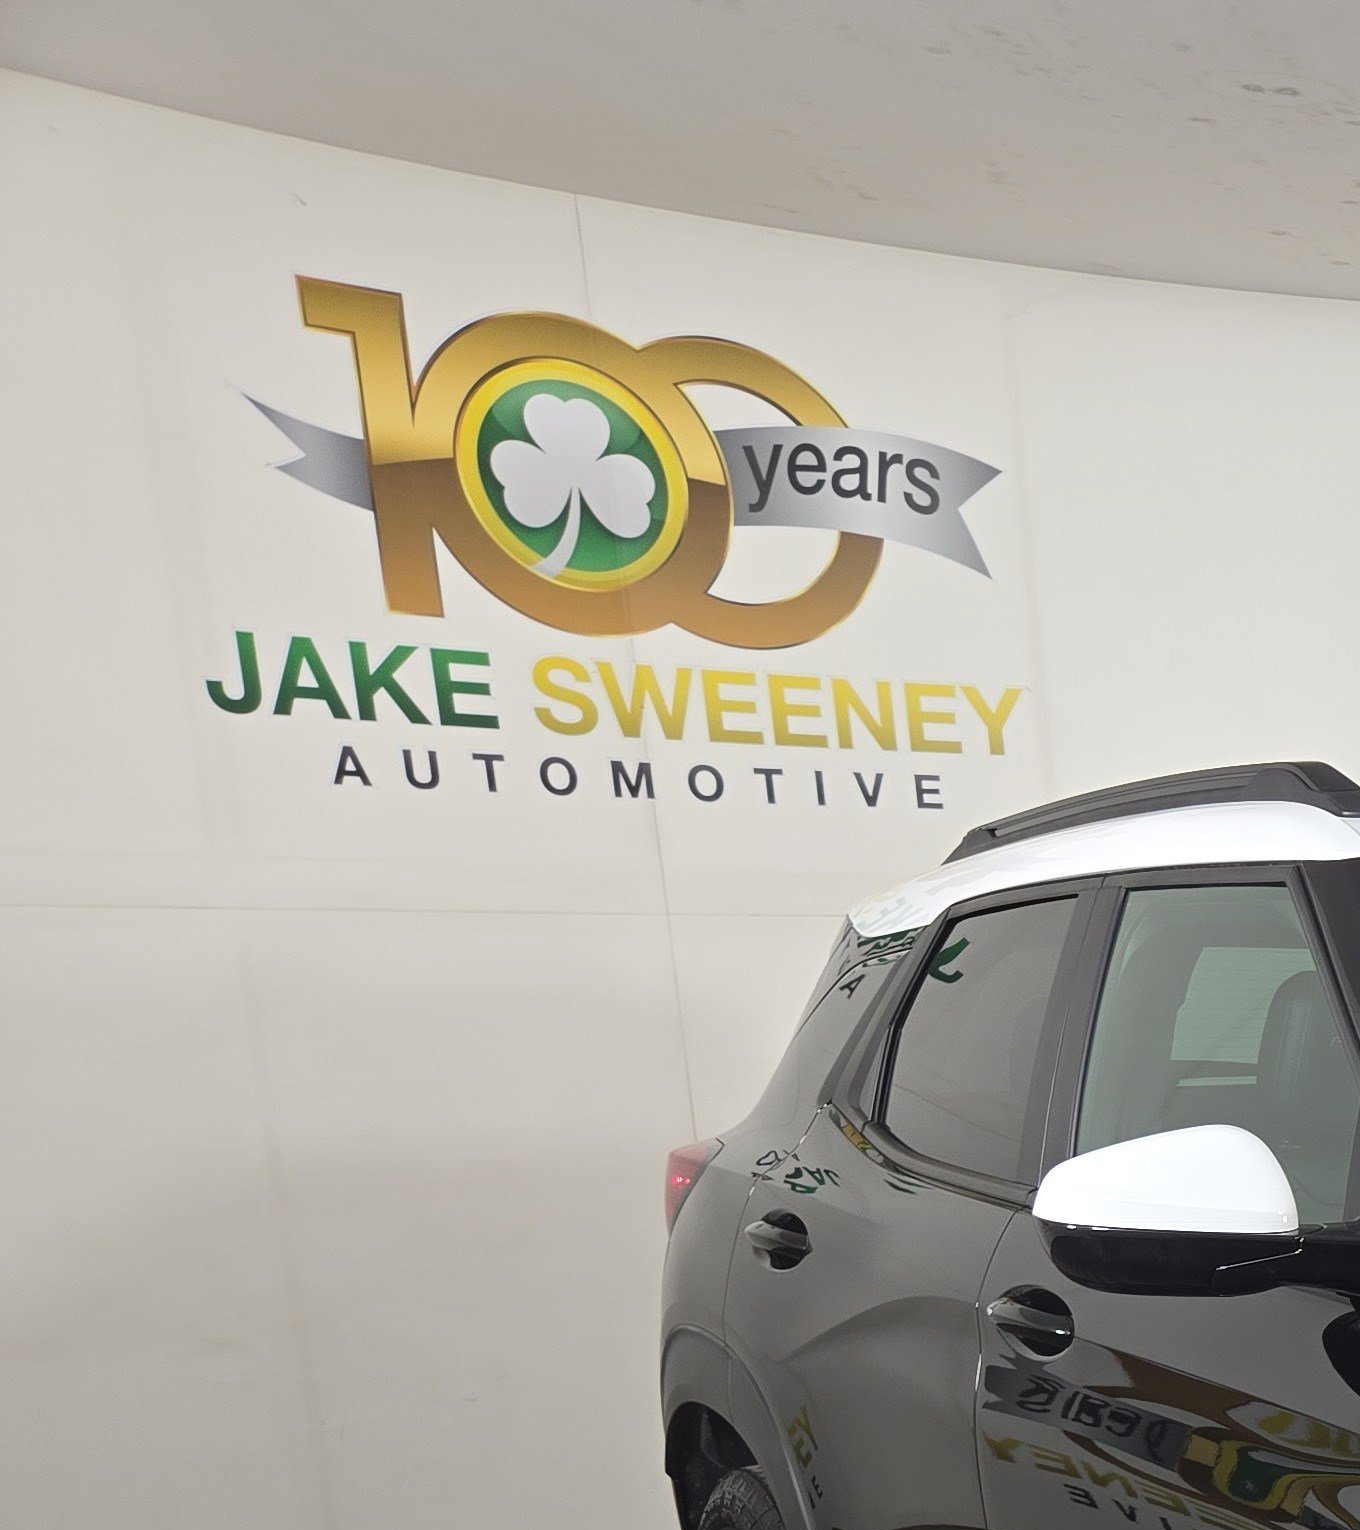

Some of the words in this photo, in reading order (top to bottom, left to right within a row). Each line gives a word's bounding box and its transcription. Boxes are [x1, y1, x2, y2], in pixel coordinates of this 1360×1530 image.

[742, 441, 943, 515] years
[206, 629, 501, 730] JAKE
[531, 655, 1023, 757] SWEENEY
[334, 745, 945, 810] AUTOMOTIVE
